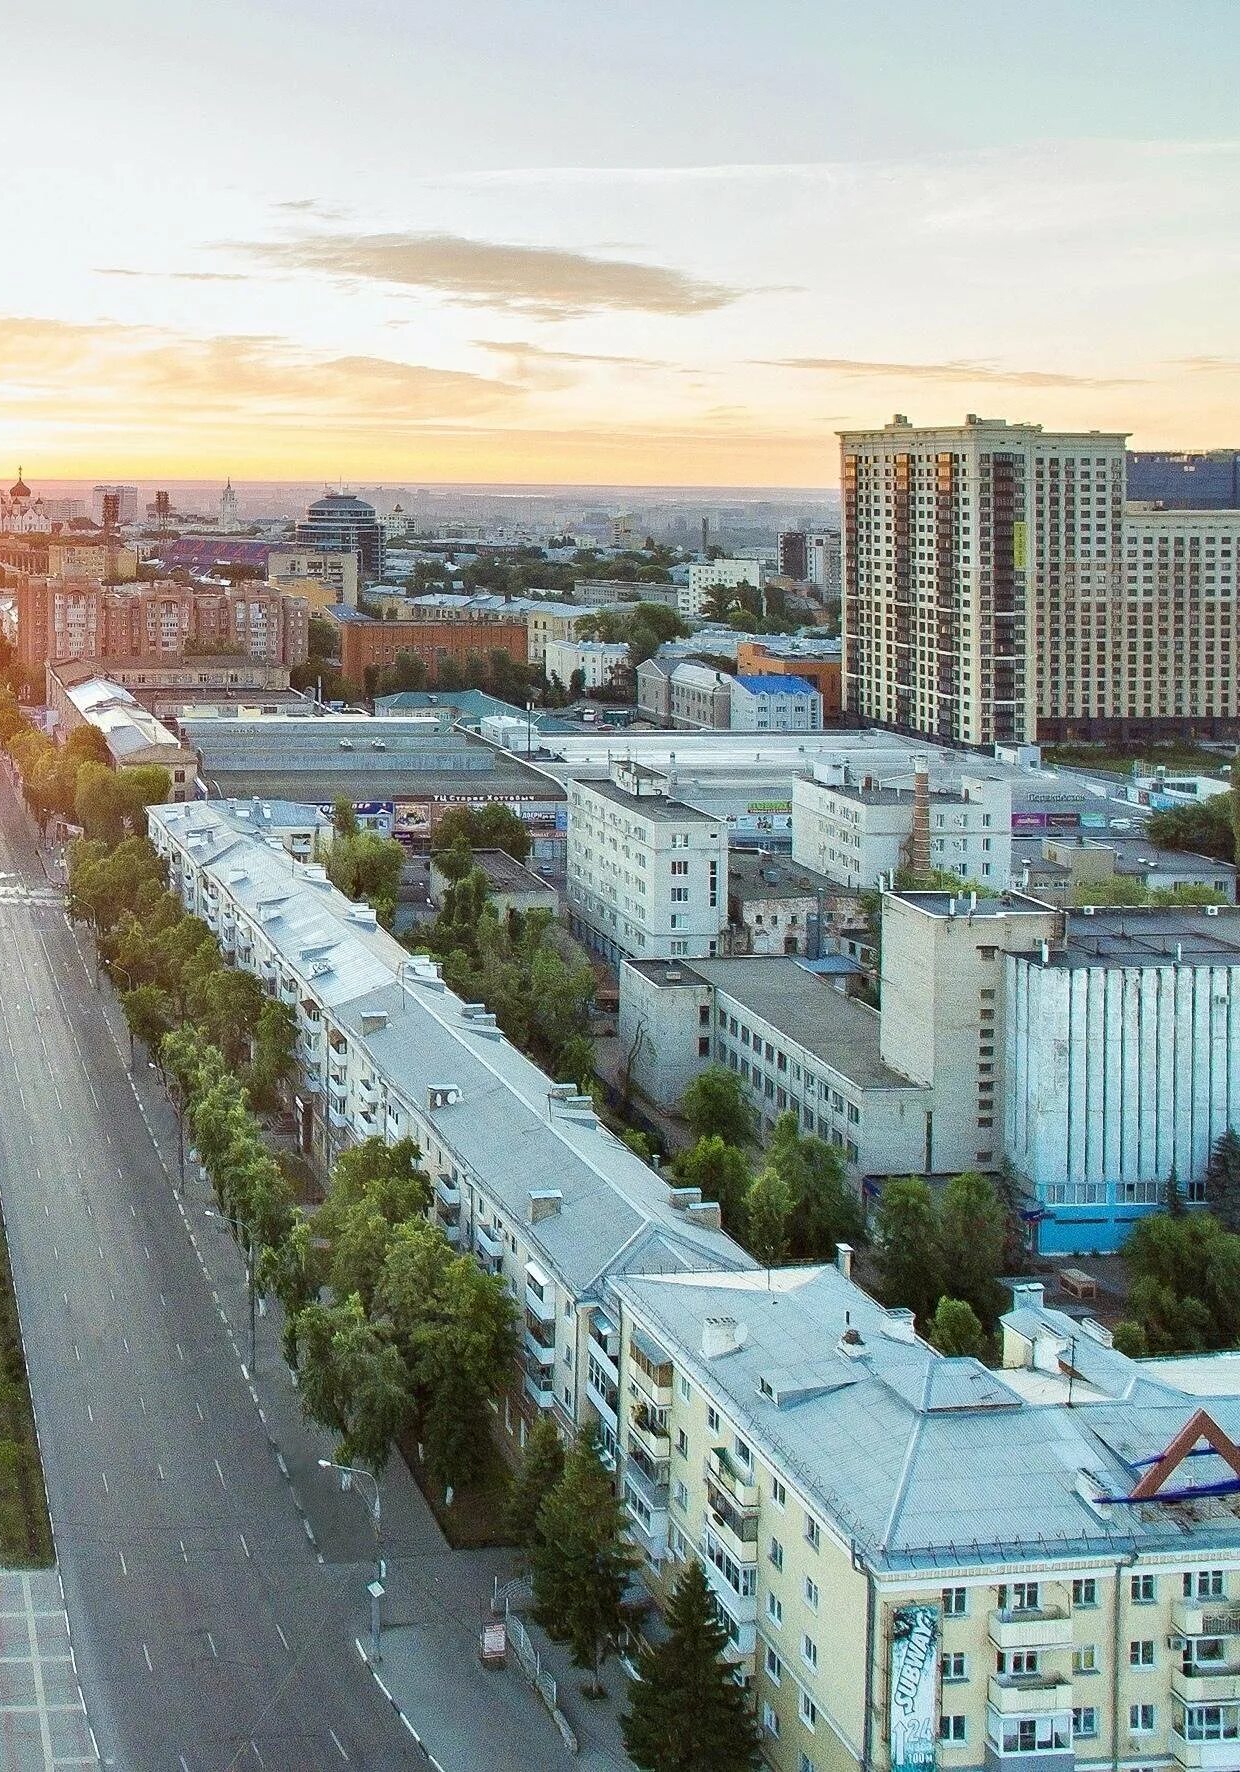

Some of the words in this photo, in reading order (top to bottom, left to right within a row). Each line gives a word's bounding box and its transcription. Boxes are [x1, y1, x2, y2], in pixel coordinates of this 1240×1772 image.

[433, 795, 447, 803] ТЦ
[894, 1611, 933, 1716] SUBWAY
[907, 1717, 934, 1743] 24
[908, 1752, 925, 1764] 100
